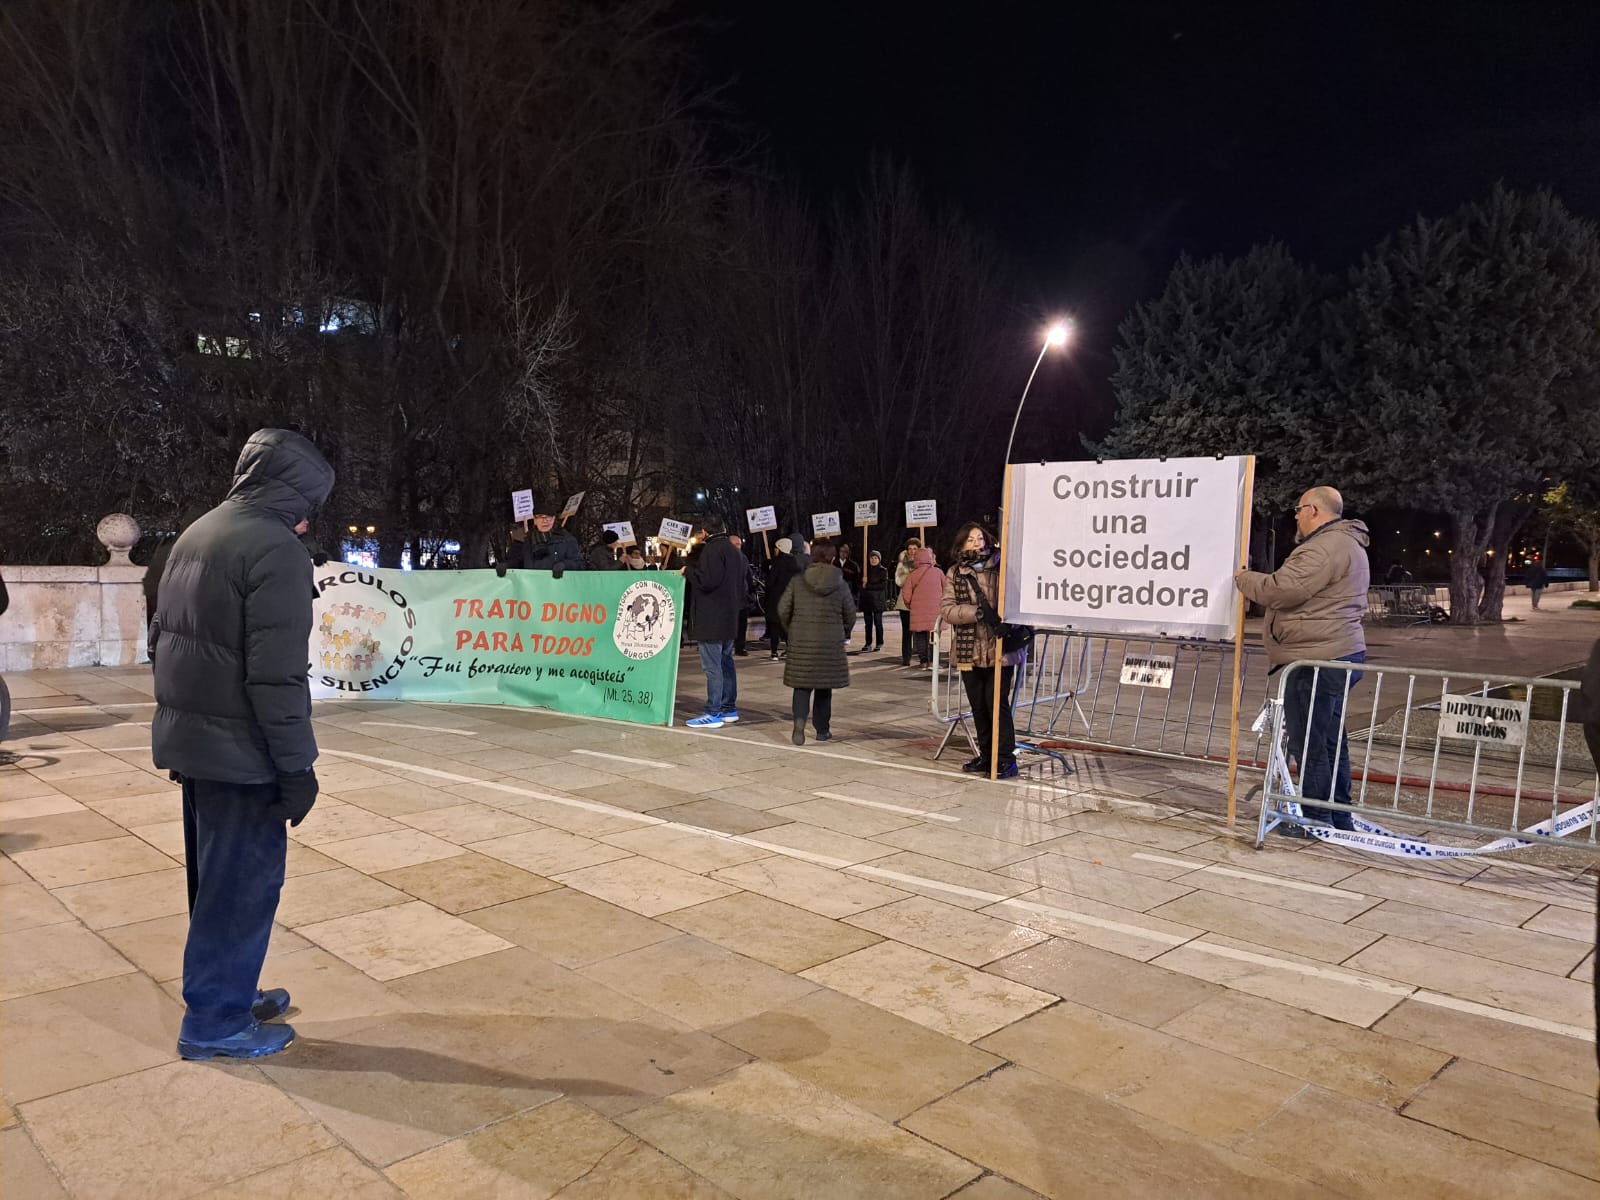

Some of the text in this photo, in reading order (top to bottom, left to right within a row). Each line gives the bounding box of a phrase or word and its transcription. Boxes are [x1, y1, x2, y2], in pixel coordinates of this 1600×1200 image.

[1052, 472, 1199, 500] Construir
[1092, 515, 1147, 534] una
[1052, 544, 1191, 571] sociedad
[616, 582, 675, 623] PASTORAL CON INMIGRANTES
[1036, 575, 1209, 610] integradora
[453, 598, 607, 625] TRATO DIGNO
[455, 629, 596, 656] PARA TODOS
[623, 647, 654, 660] BURGOS
[320, 635, 414, 692] SILENCIO
[467, 657, 532, 679] forastero
[535, 665, 543, 681] y
[548, 666, 566, 678] me
[622, 689, 635, 705] 25,
[638, 690, 654, 708] 38)
[1446, 701, 1523, 722] DIPUTACION
[1456, 721, 1507, 740] BURGOS
